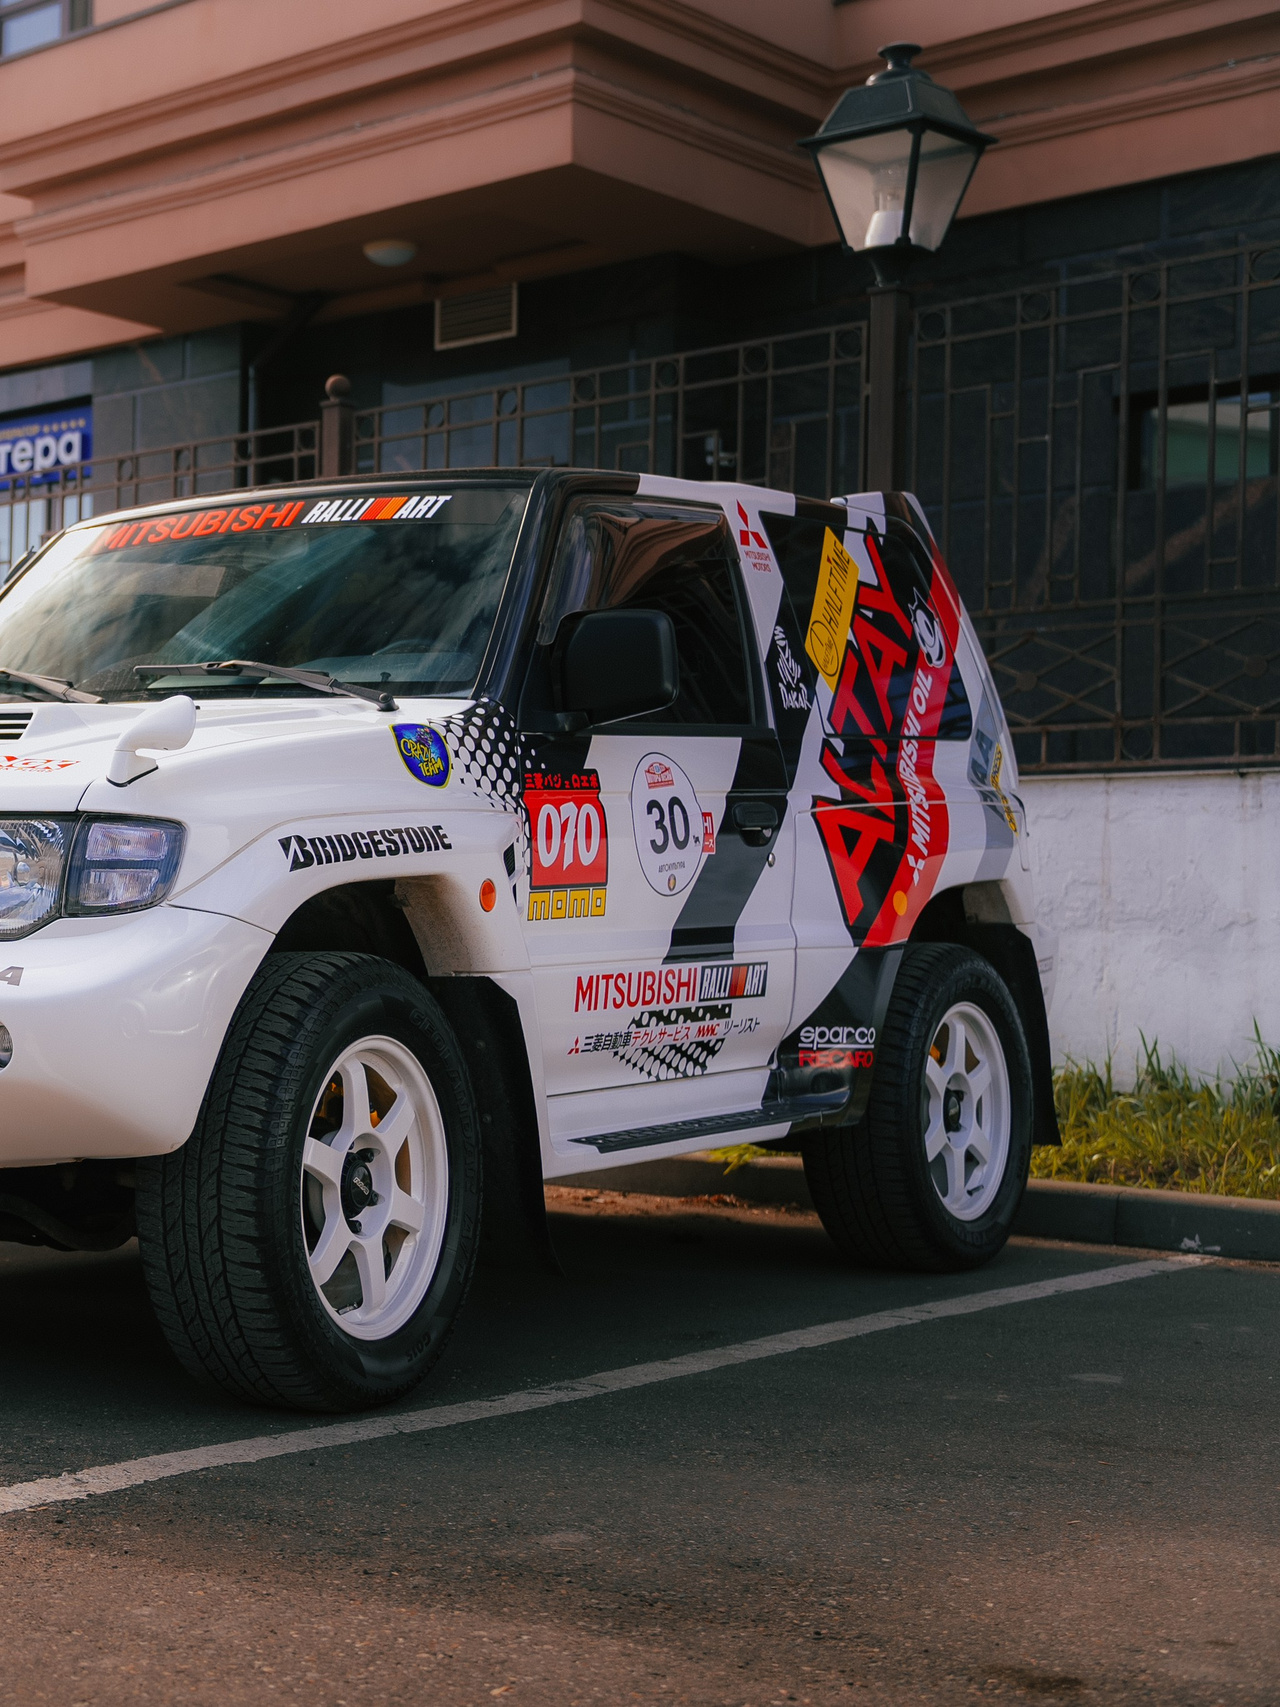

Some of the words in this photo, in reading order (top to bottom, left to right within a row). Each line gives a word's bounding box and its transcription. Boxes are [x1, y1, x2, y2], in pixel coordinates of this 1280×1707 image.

[91, 501, 306, 553] MITSUBISHI
[744, 550, 772, 562] MITSUBISHI
[752, 561, 772, 573] MOTORS
[822, 540, 850, 636] HALFTIME
[778, 682, 812, 710] DAKAR
[912, 668, 933, 715] OIL
[401, 738, 431, 762] CRAZY
[816, 532, 914, 927] ALTAY
[418, 757, 444, 776] TEAM
[899, 708, 931, 856] MITSUBISHI
[537, 801, 600, 871] 070
[646, 796, 690, 854] 30
[277, 825, 453, 872] BRIDGESTONE
[574, 967, 698, 1012] MITSUBISHI
[798, 1049, 874, 1069] RECARO
[799, 1026, 876, 1050] sparco
